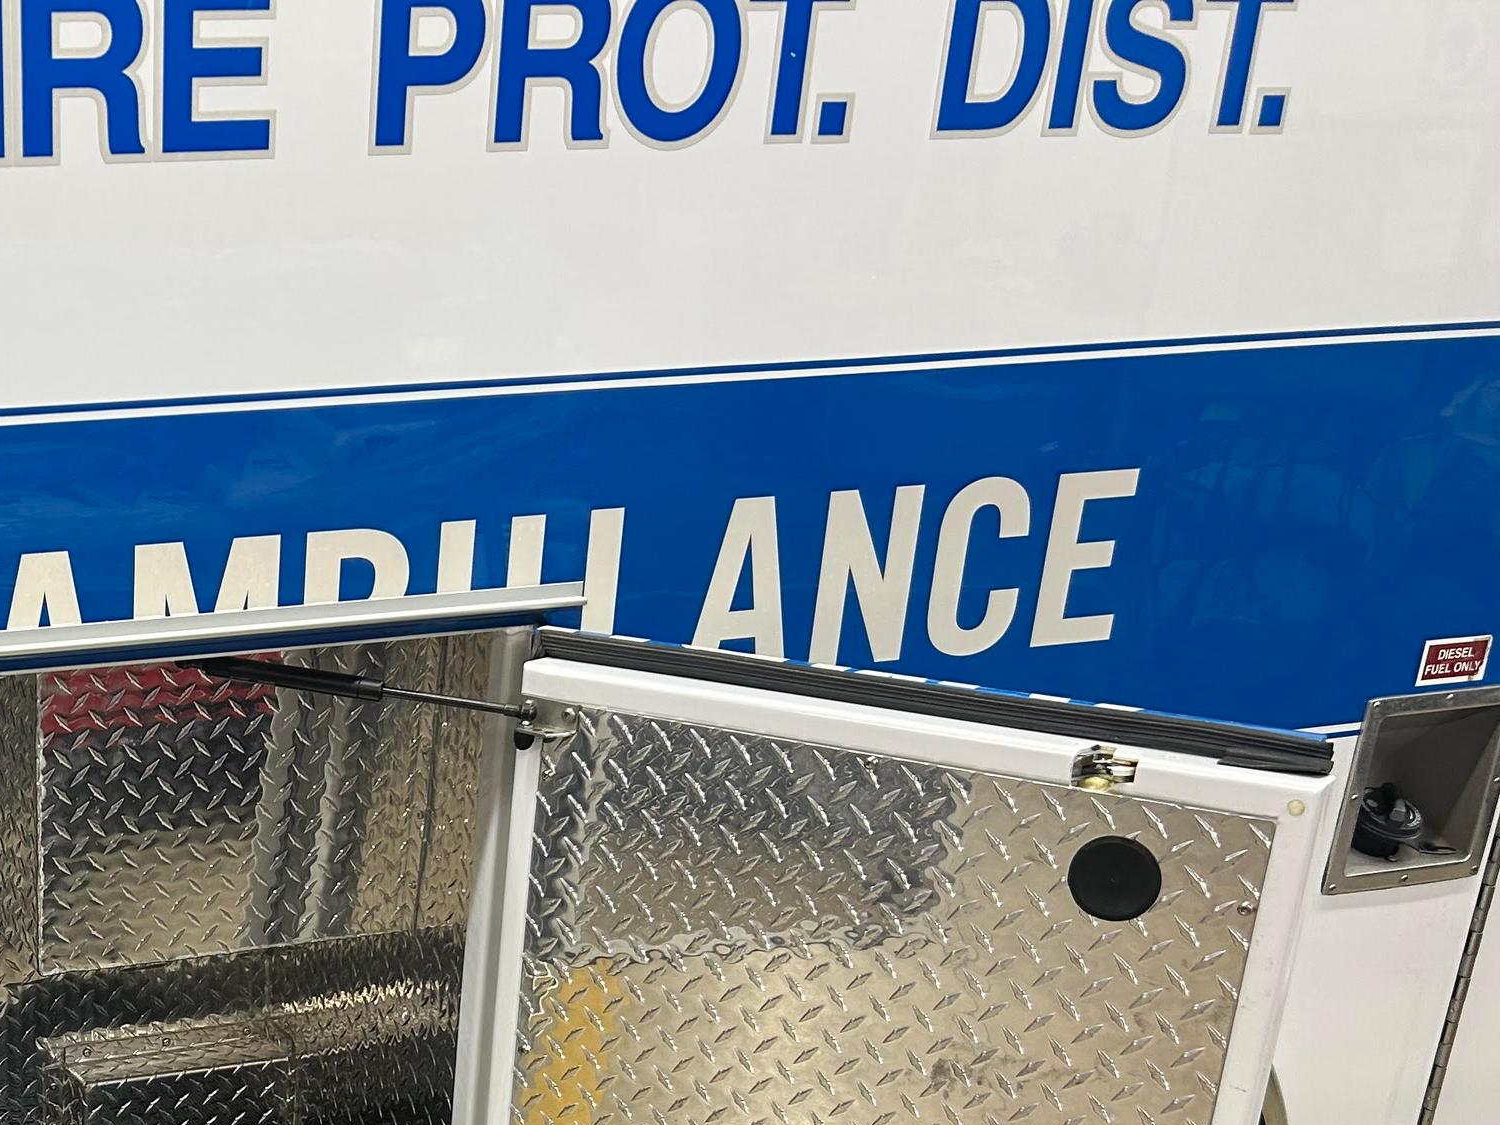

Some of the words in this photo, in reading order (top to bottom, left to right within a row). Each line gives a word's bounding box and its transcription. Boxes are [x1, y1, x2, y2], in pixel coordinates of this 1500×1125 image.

[368, 0, 856, 155] PROT.
[930, 0, 1298, 139] DIST.
[1437, 647, 1475, 660] DIESEL
[1424, 663, 1451, 675] FUEL
[1453, 660, 1481, 673] ONLY
